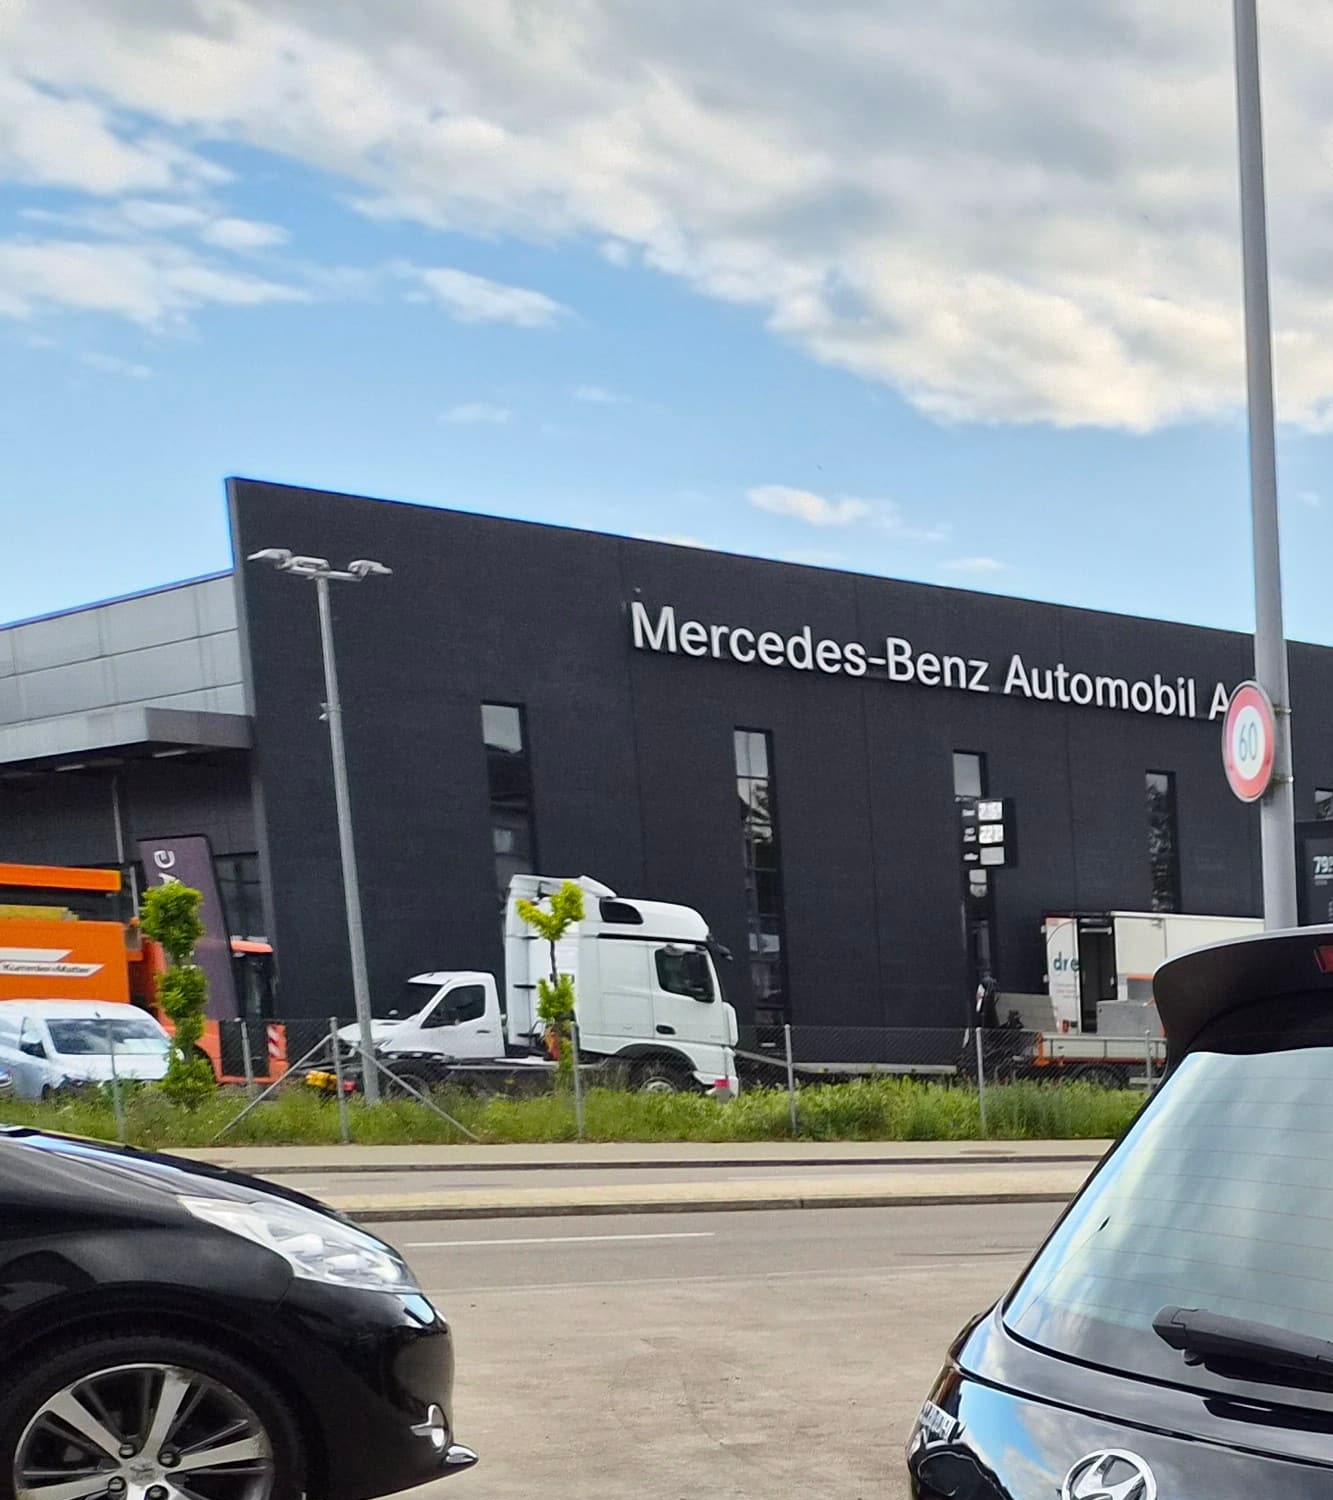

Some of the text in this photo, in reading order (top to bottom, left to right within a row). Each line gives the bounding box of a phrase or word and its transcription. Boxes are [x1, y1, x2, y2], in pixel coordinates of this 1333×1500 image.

[631, 600, 990, 693] Mercedes-Benz
[1003, 654, 1196, 718] Automobil
[1238, 721, 1258, 763] 60
